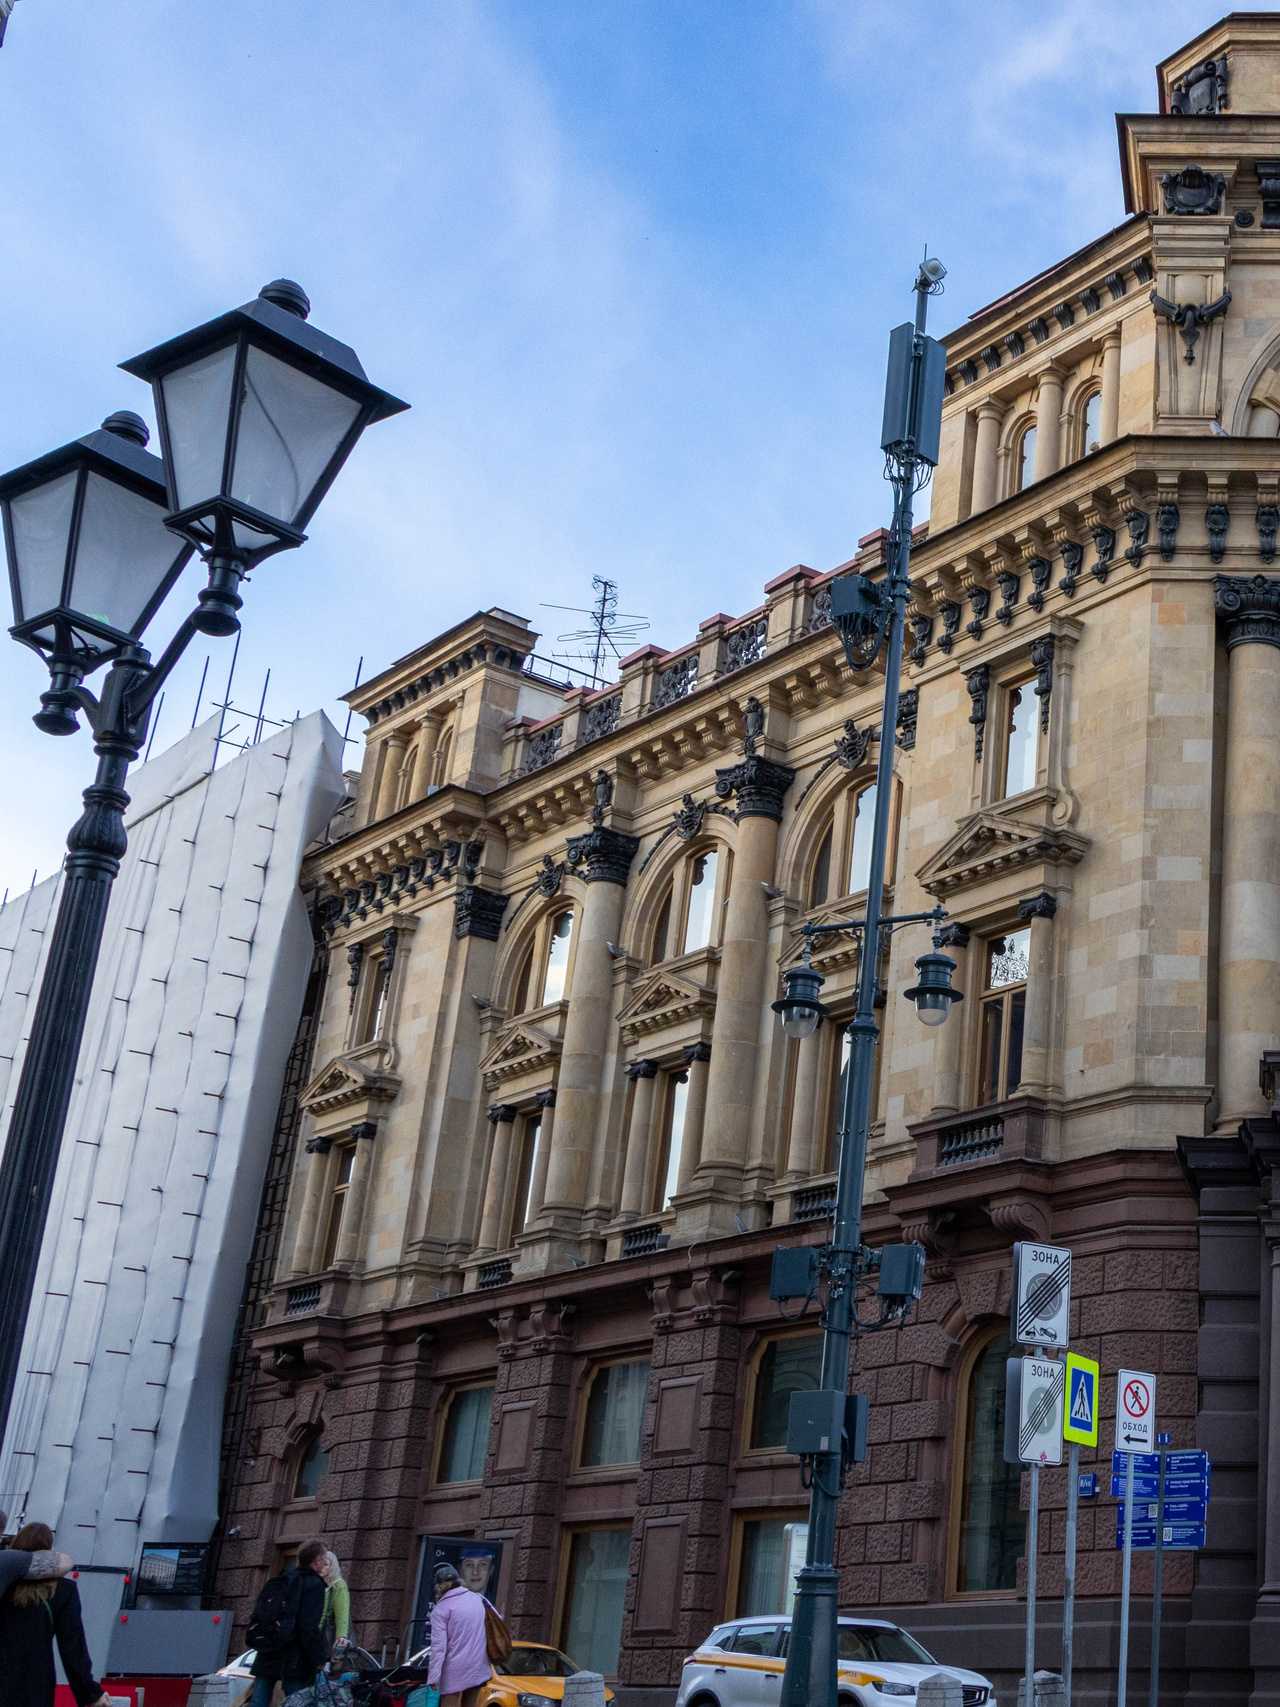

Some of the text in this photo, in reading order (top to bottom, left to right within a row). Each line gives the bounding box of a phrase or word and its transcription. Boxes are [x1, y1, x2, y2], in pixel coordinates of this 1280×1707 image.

[1031, 1250, 1060, 1265] ЗОНА
[1031, 1364, 1056, 1379] ЗОНА
[1122, 1421, 1148, 1434] ОБХОД
